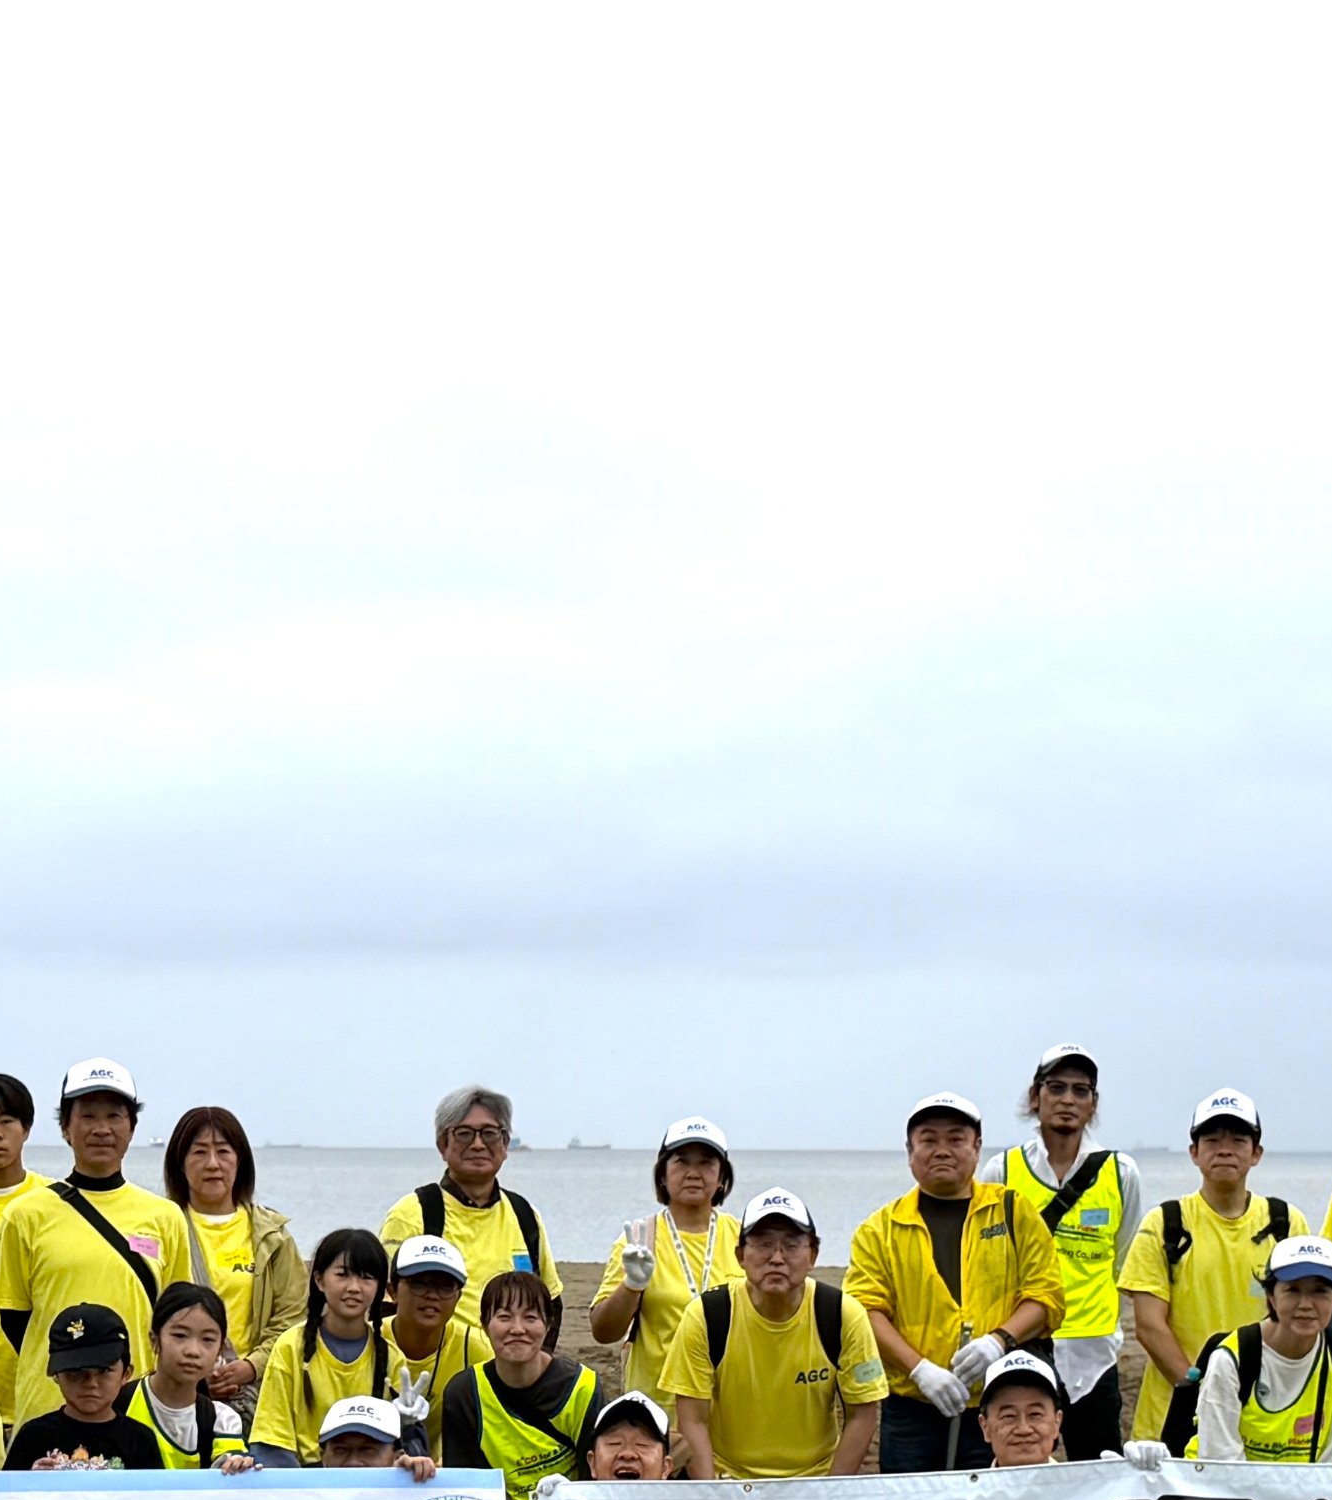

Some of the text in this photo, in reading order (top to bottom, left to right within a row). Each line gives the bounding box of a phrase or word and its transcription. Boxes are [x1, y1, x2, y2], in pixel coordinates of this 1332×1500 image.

[90, 1069, 114, 1079] AGC
[1211, 1097, 1238, 1107] AGC
[687, 1123, 708, 1132] AGC
[763, 1196, 791, 1206] AGC
[422, 1245, 446, 1255] AGC
[1298, 1245, 1323, 1255] AGC
[232, 1263, 255, 1273] AG
[1004, 1357, 1036, 1368] AGC
[794, 1367, 829, 1384] AGC
[348, 1405, 374, 1415] AGC
